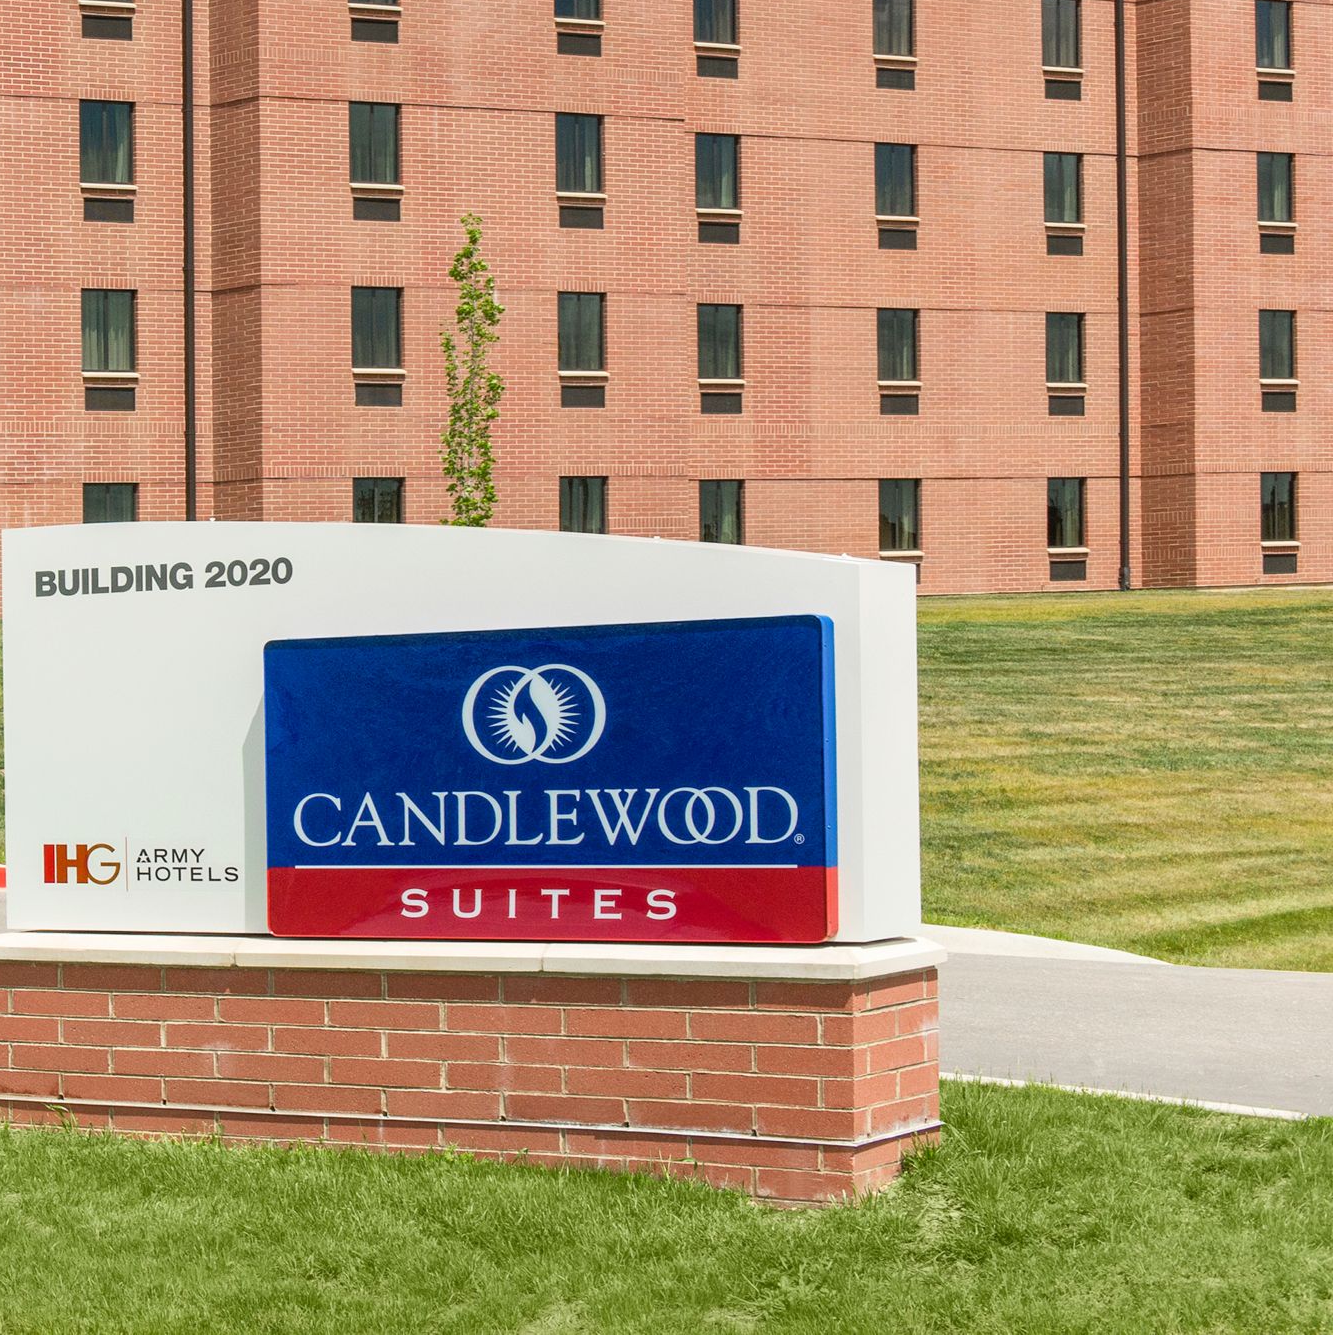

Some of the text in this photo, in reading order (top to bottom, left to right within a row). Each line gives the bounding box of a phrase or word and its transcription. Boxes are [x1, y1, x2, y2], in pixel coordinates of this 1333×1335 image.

[35, 556, 294, 598] BUILDING 2020
[43, 843, 121, 886] IHG
[136, 848, 206, 864] ARMY
[136, 866, 239, 883] HOTELS
[400, 888, 678, 921] SUITES
